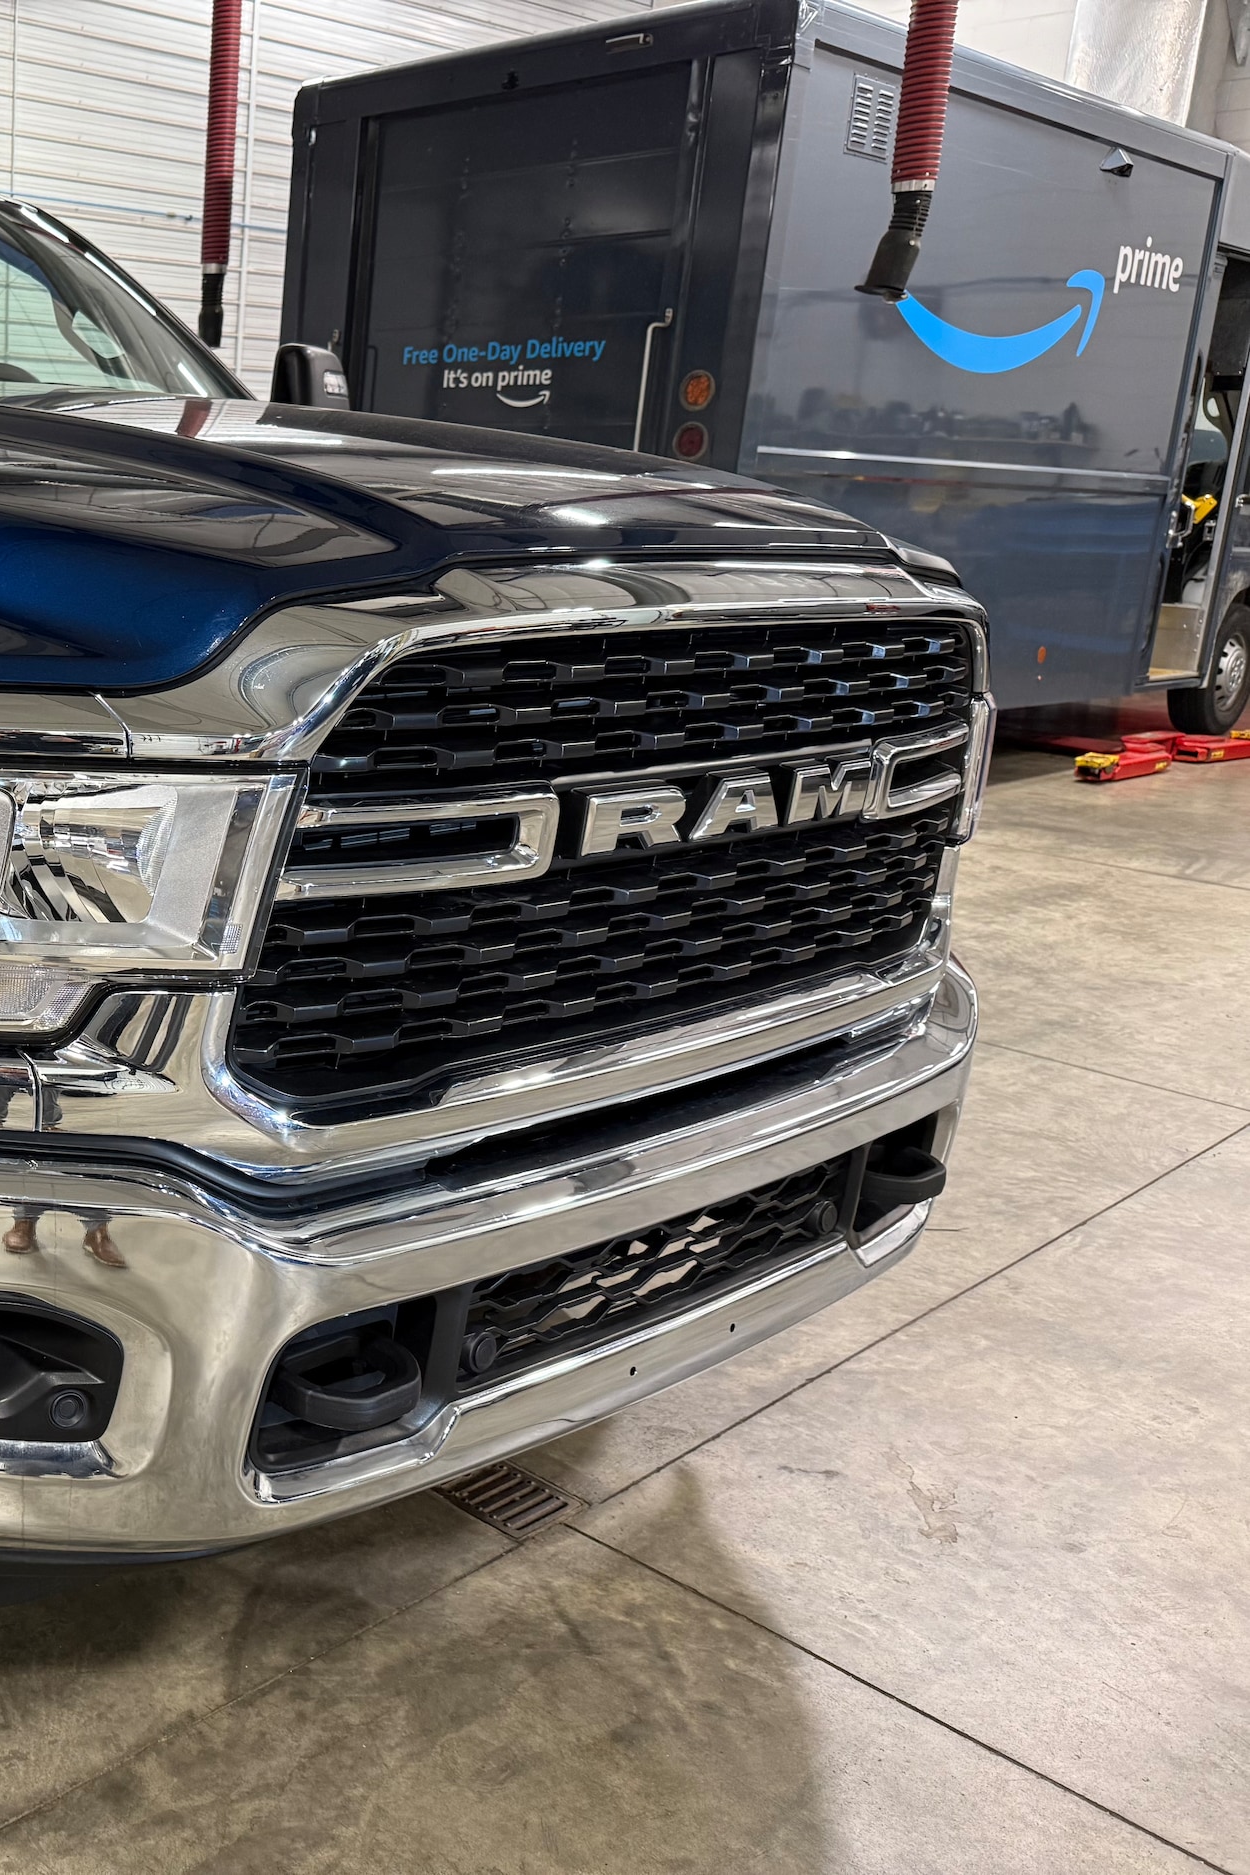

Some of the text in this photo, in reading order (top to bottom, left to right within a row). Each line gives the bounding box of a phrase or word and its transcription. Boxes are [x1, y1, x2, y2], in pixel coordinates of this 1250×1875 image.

[1113, 236, 1184, 294] prime
[403, 336, 606, 365] Free One-Day Delivery
[443, 365, 552, 391] It's on prime
[581, 760, 871, 857] RAM
